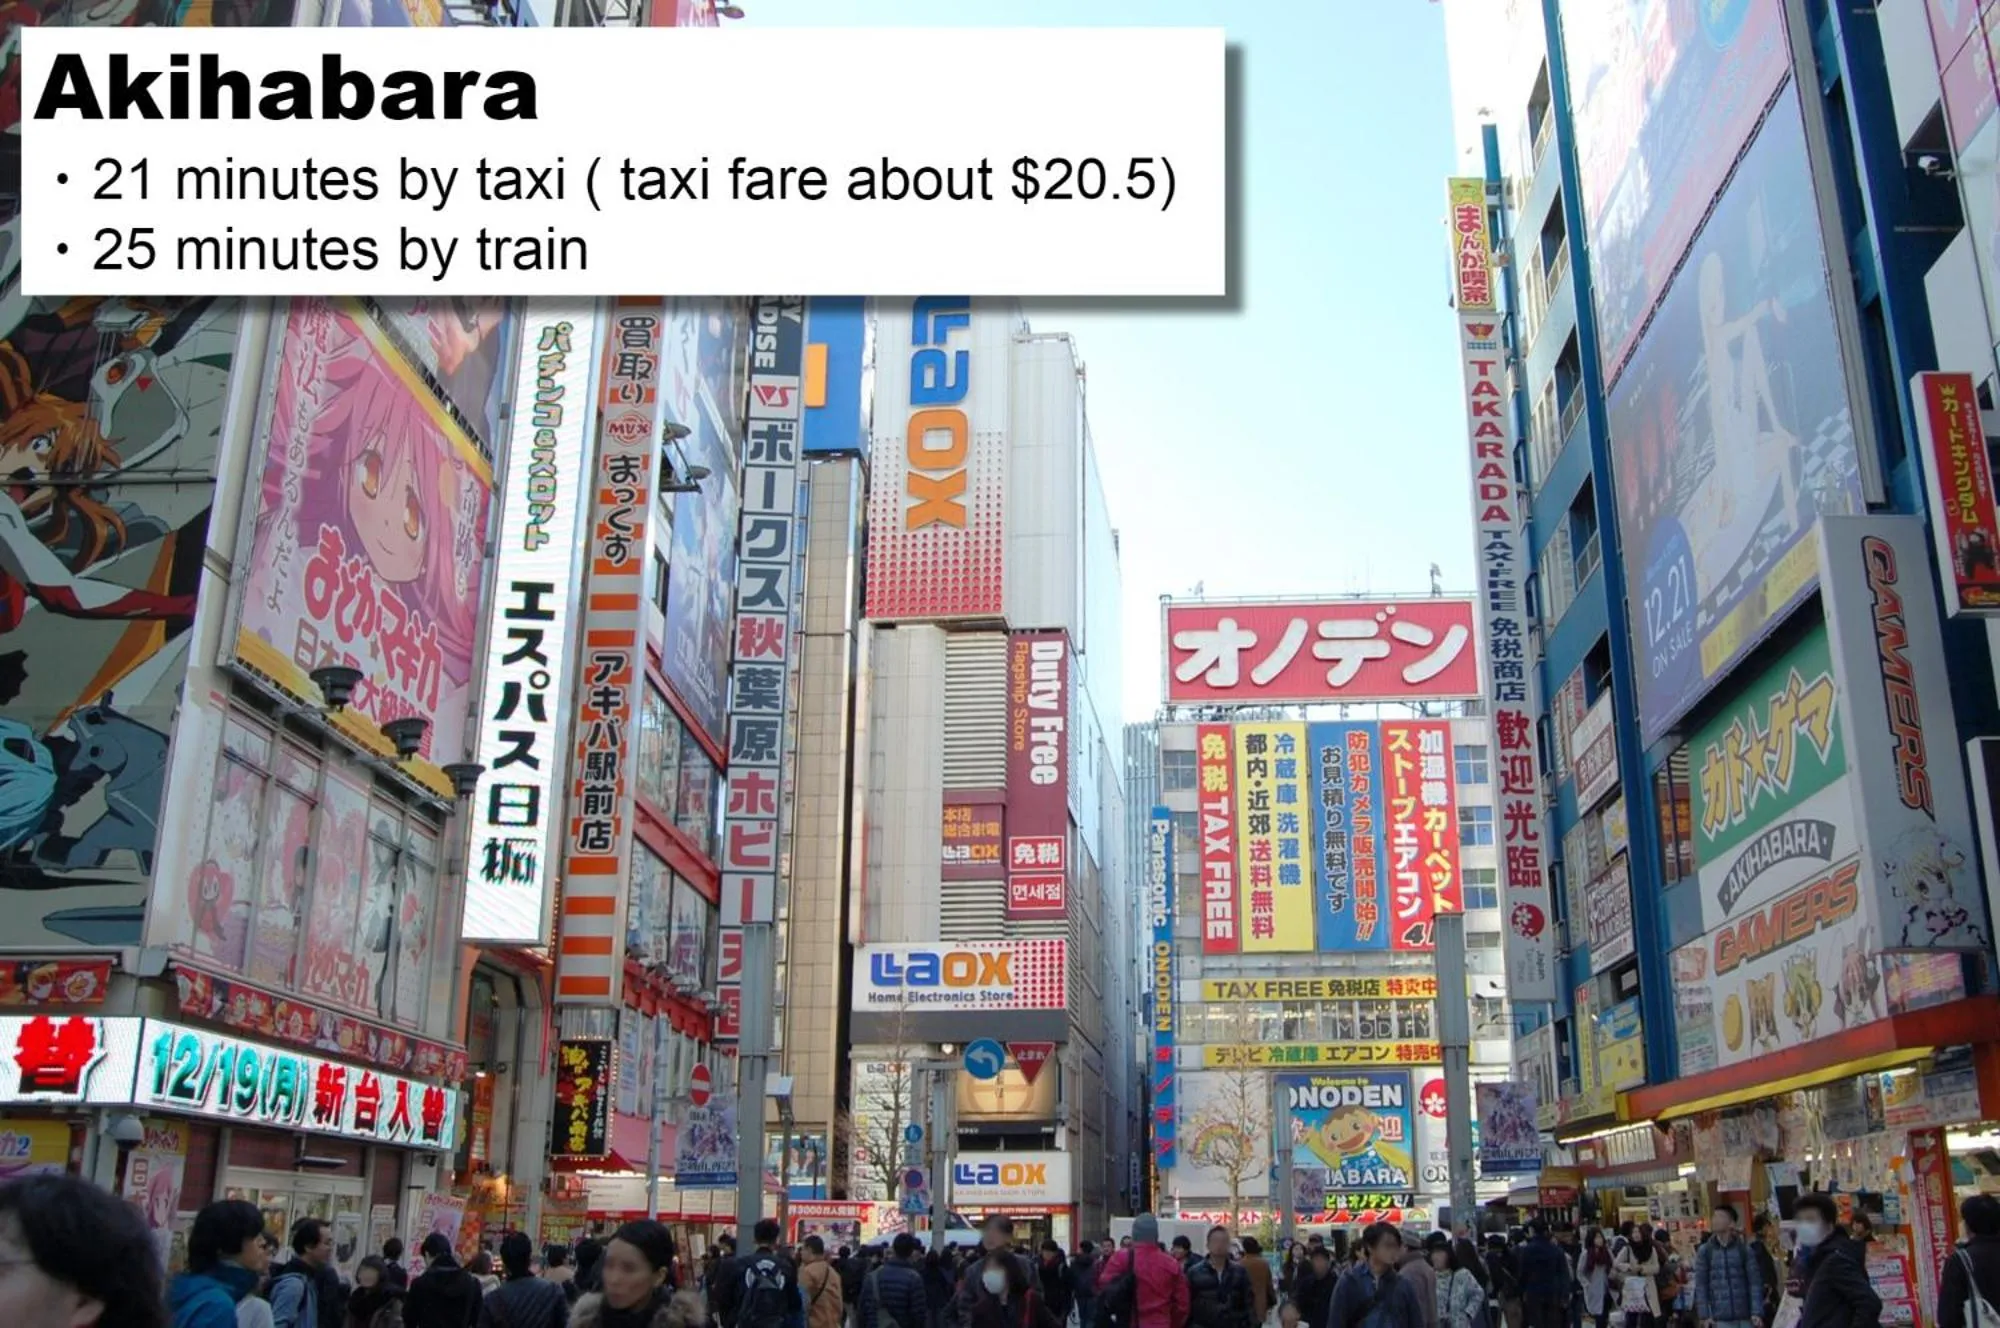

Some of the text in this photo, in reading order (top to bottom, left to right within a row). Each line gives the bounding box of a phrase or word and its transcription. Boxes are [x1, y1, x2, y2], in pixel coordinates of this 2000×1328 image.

[1455, 204, 1489, 304] まんが喫茶
[616, 316, 656, 404] 買取り
[1469, 360, 1511, 521] TAKARADA
[604, 455, 642, 565] まっくす
[1173, 605, 1469, 688] オノデン
[1644, 555, 1689, 648] 12.21
[1653, 620, 1693, 678] ON SALE
[1011, 641, 1029, 751] Flagship Store
[1490, 617, 1526, 701] 免税商店
[1862, 536, 1935, 822] GAMERS
[579, 653, 624, 850] アキバ駅前店
[1030, 641, 1064, 785] Duty Free
[1014, 842, 1061, 864] 免税
[1201, 733, 1233, 940] 免税 TAX FREE
[1274, 733, 1301, 886] 冷蔵庫洗濯機
[1321, 747, 1347, 912] お見積り無料です
[1152, 819, 1171, 928] Panasonic
[1728, 823, 1821, 902] AKIHABARA
[1714, 860, 1859, 976] GAMERS
[868, 990, 1014, 1003] Home Electronics Store
[1155, 940, 1173, 1032] ONODEN
[1214, 981, 1257, 998] TAX
[1264, 981, 1323, 998] FREE
[1328, 979, 1381, 997] 免税店
[1017, 1049, 1045, 1061] 止まれ
[1325, 1046, 1390, 1061] エアコン
